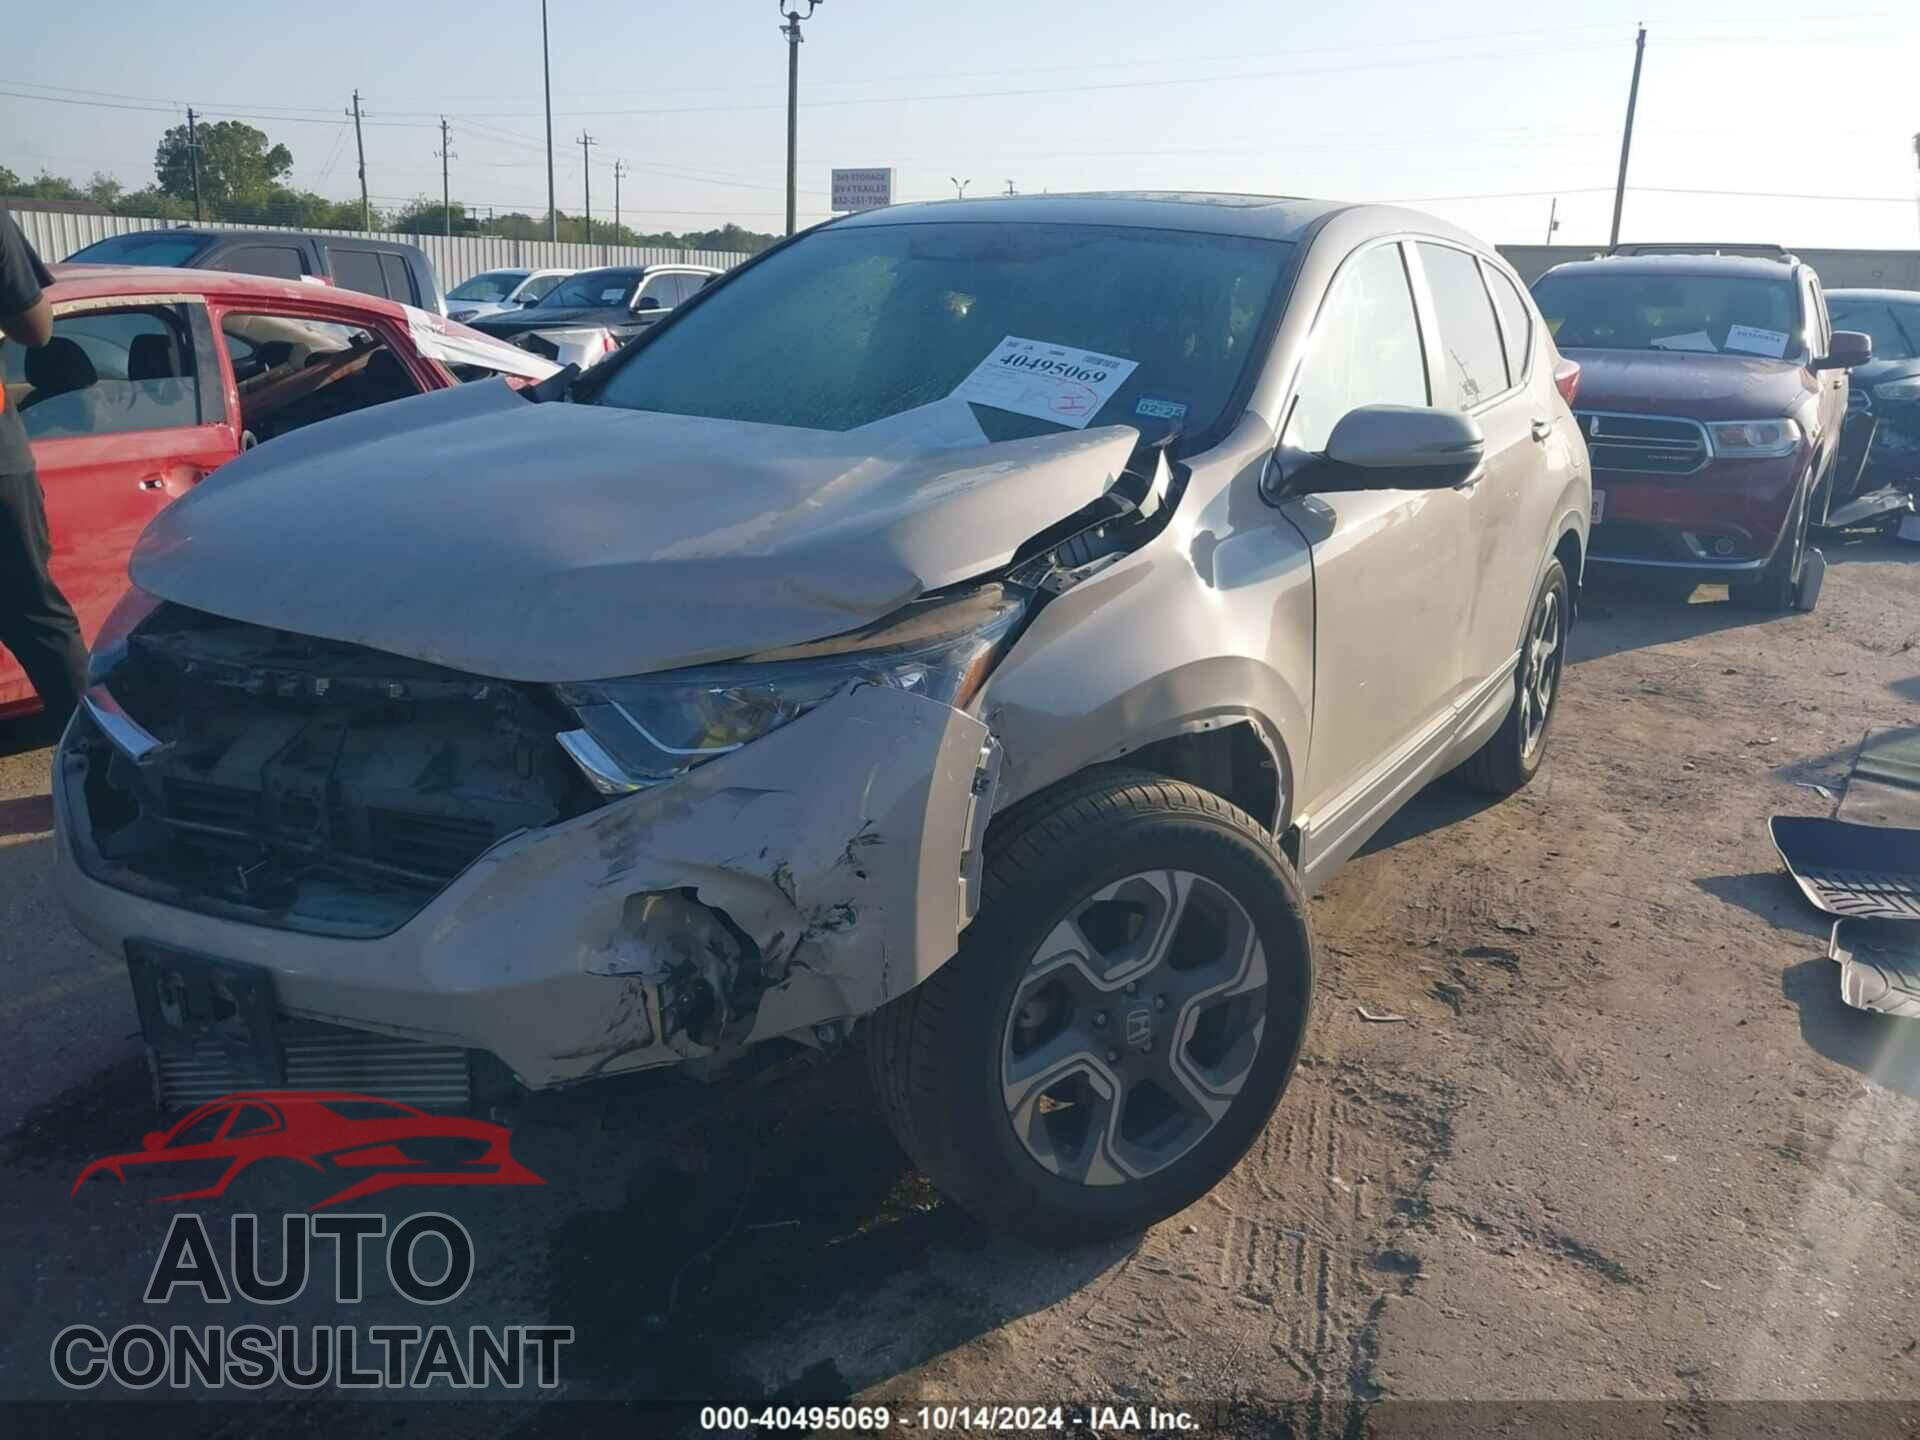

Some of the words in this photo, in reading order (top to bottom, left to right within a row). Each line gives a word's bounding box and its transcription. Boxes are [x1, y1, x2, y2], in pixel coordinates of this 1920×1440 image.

[850, 172, 886, 182] STORAGE
[853, 184, 887, 193] TRAILER
[1000, 353, 1107, 383] 40495069
